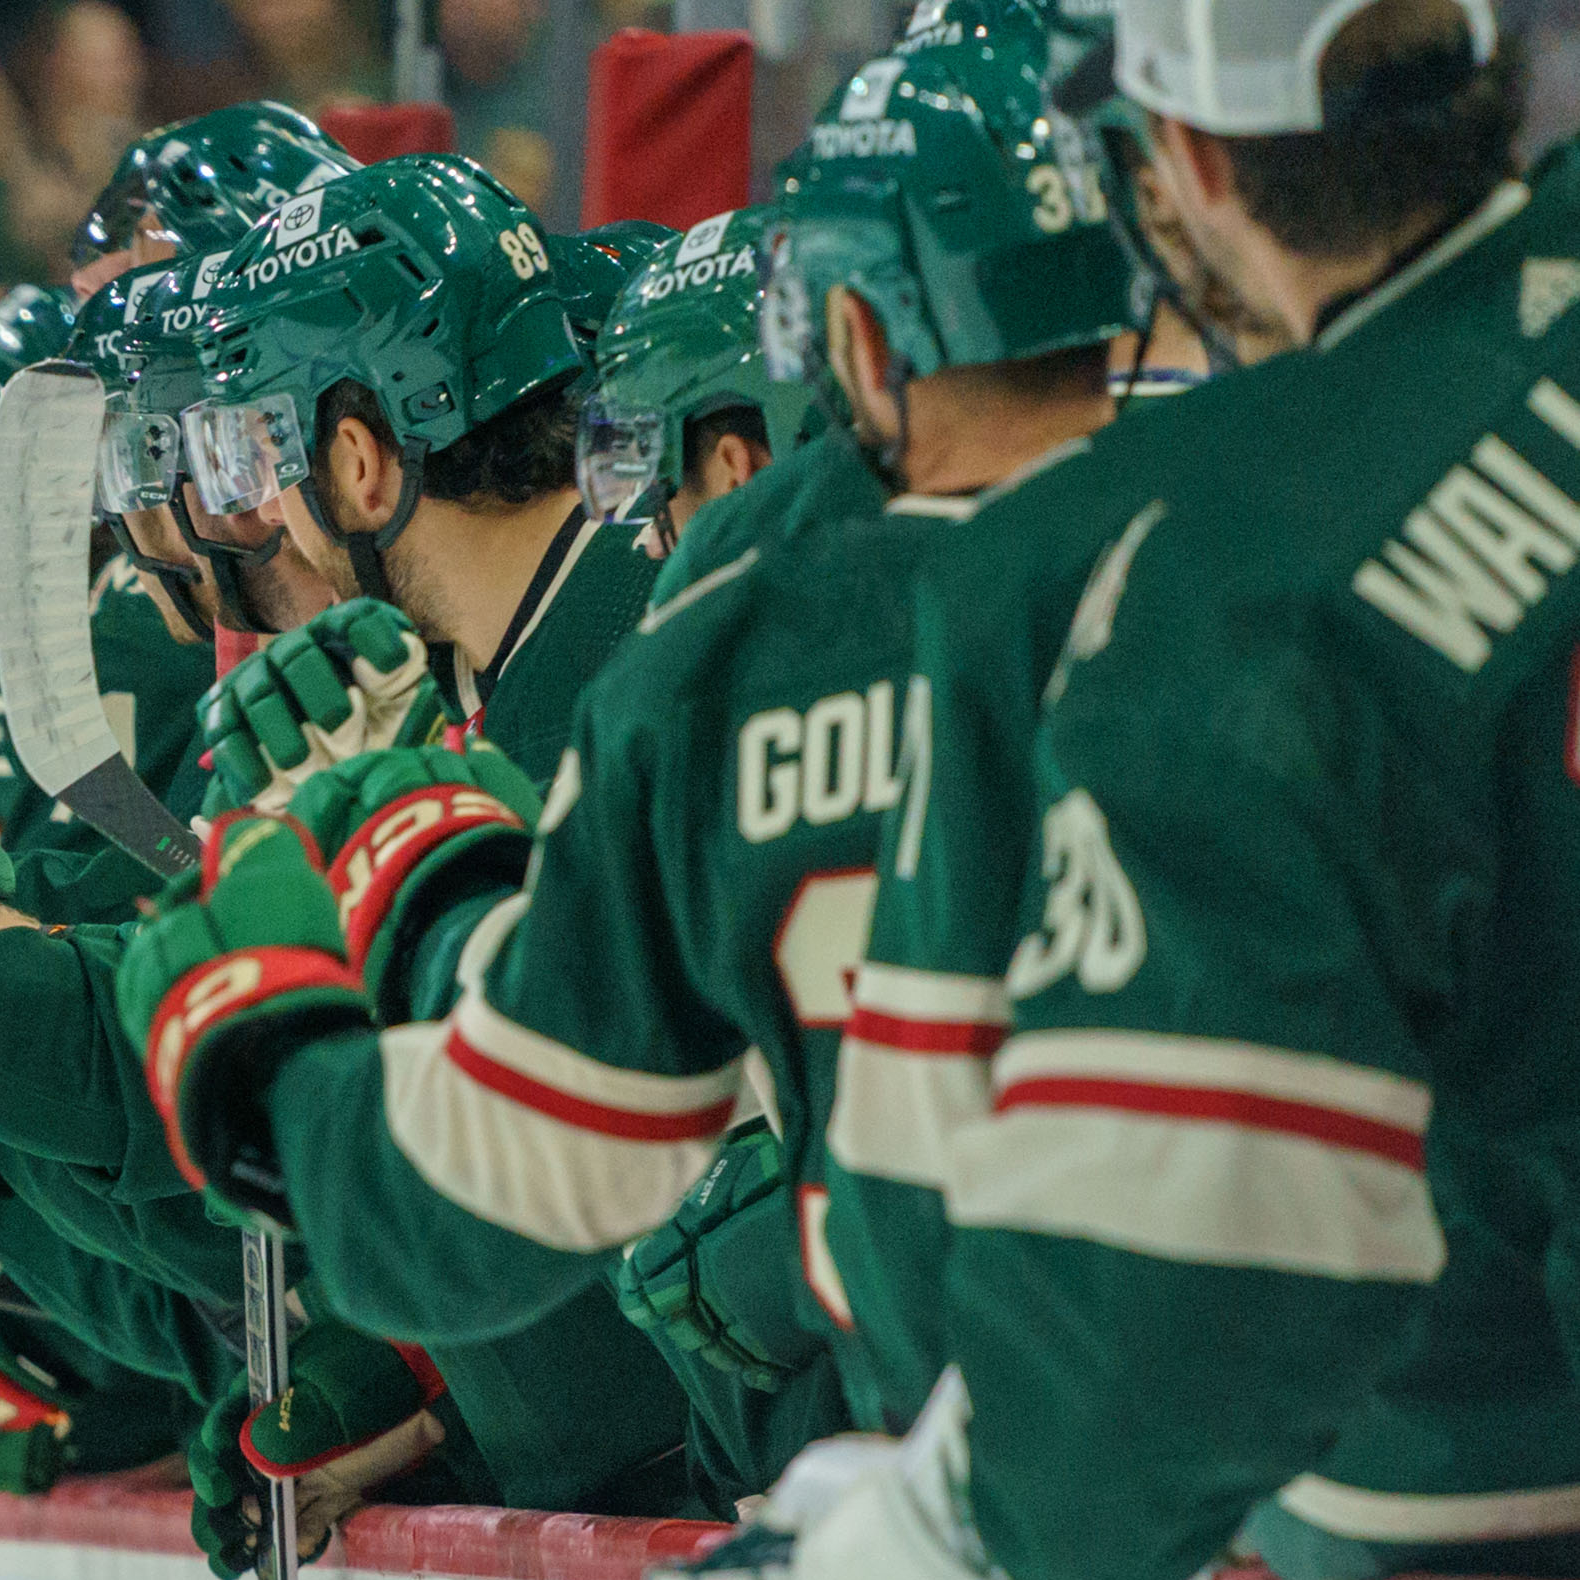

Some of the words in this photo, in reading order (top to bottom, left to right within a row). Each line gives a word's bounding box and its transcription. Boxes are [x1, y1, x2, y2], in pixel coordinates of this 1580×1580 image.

[812, 120, 917, 158] TOYOTA
[243, 226, 360, 291] TOYOTA
[498, 223, 550, 280] 89
[639, 244, 755, 308] TOYOTA
[161, 302, 209, 333] TOY
[736, 678, 909, 845] GOL
